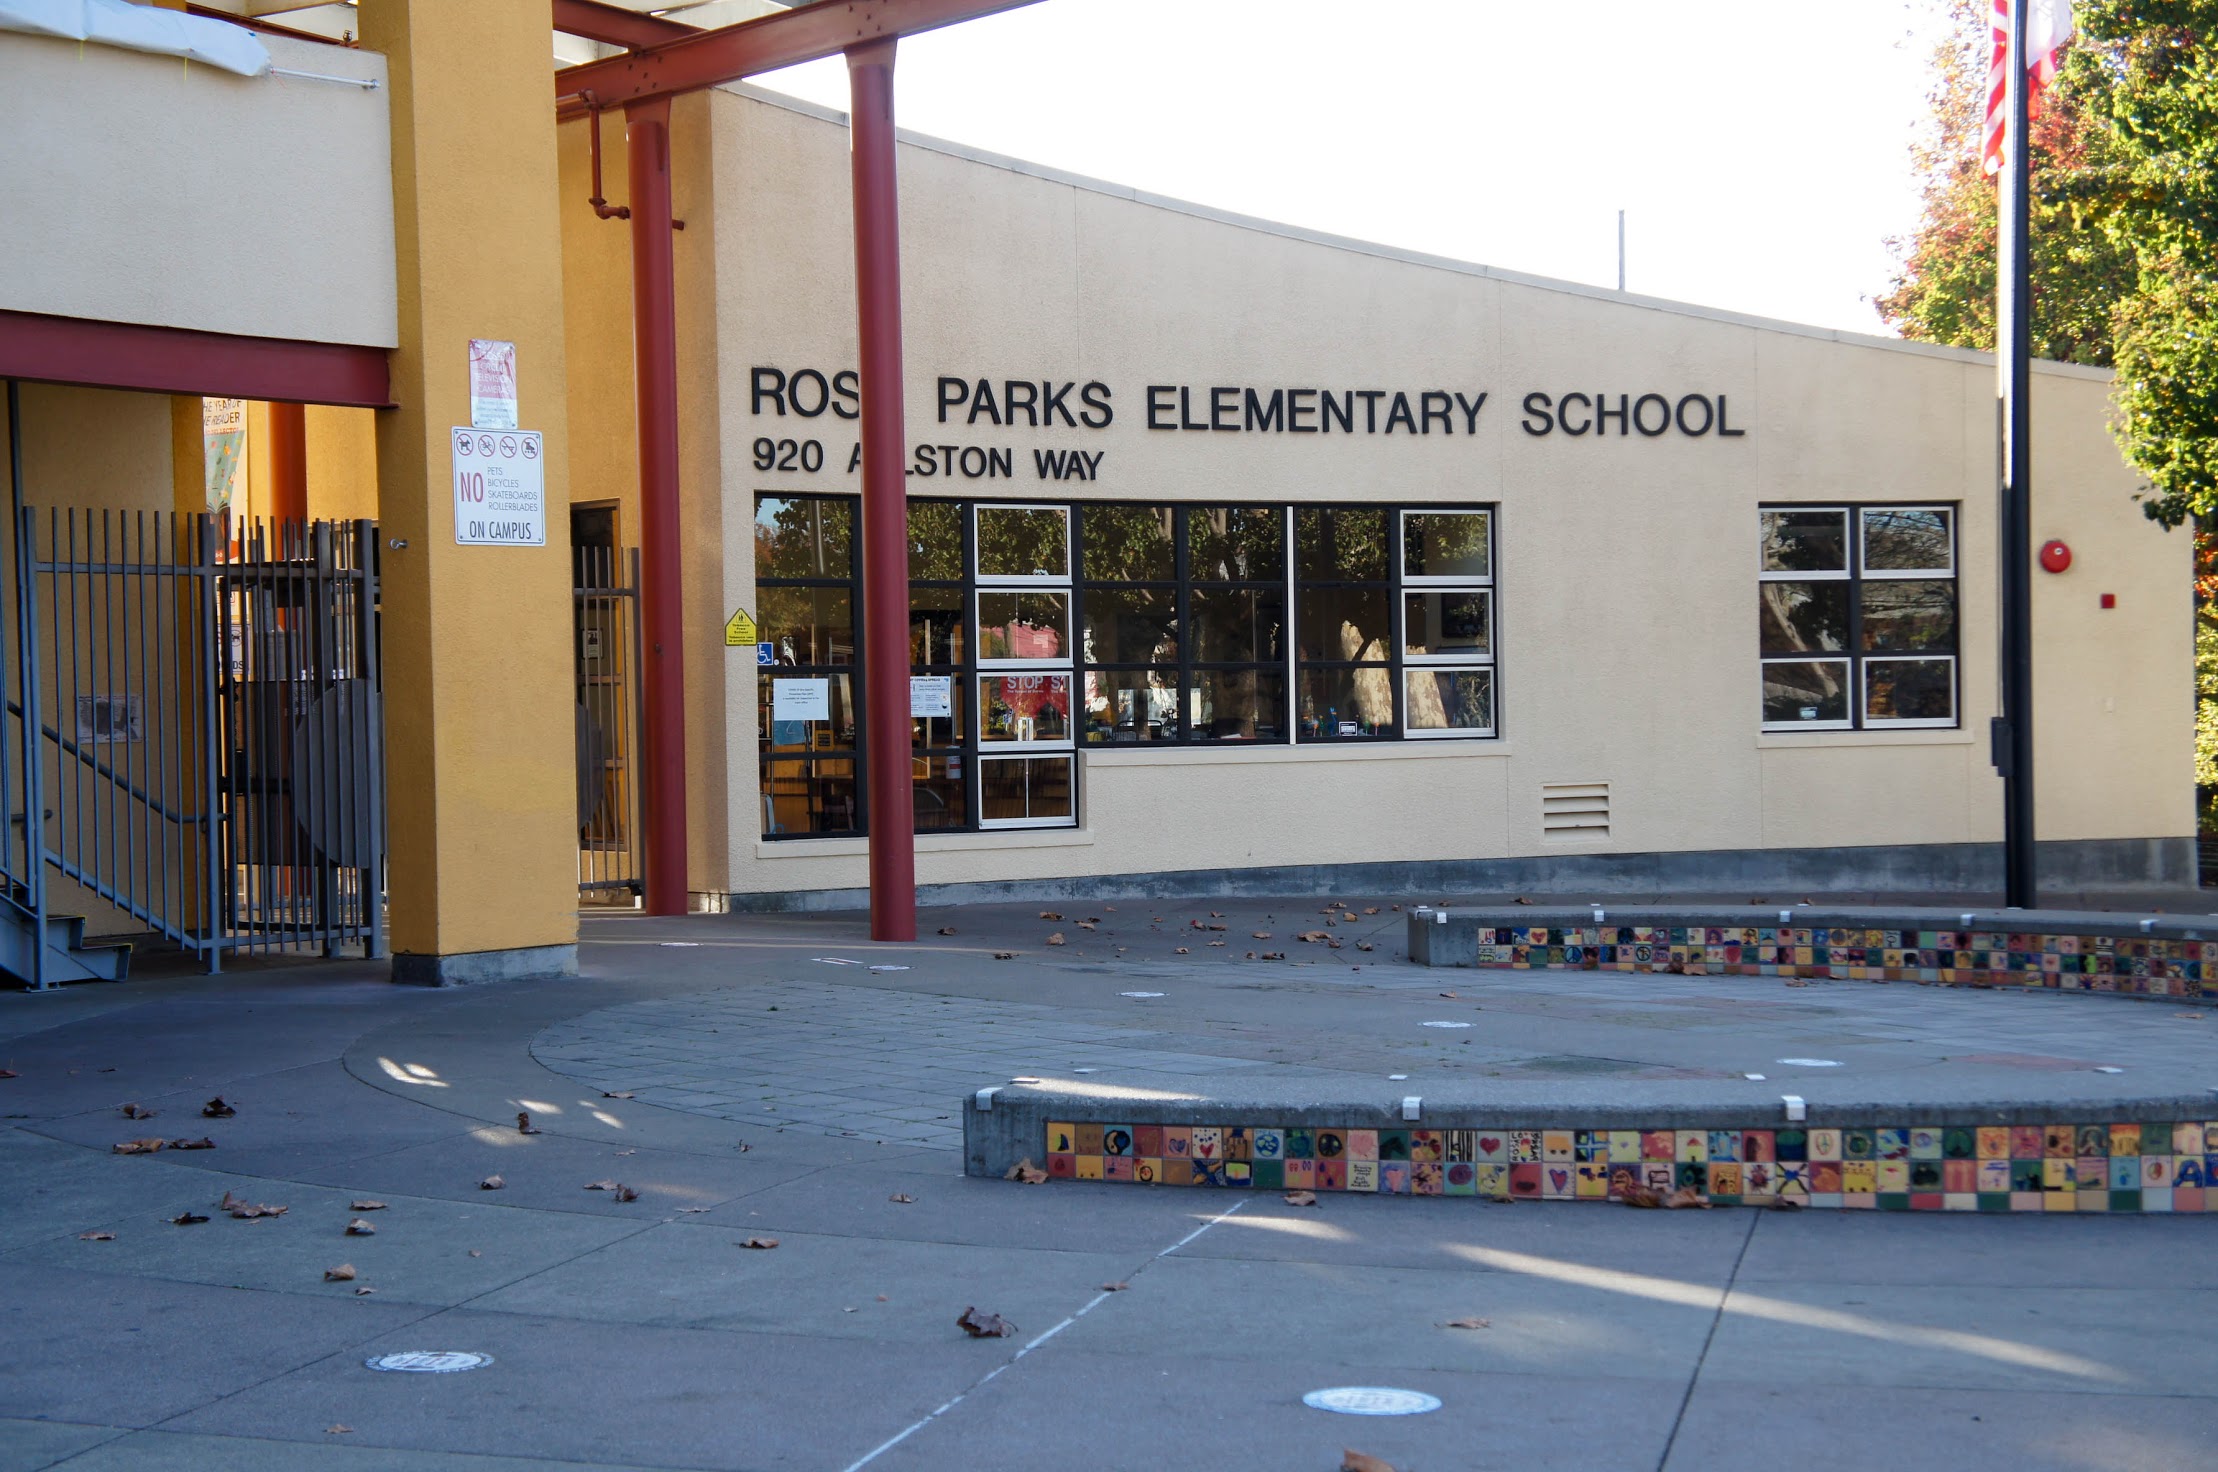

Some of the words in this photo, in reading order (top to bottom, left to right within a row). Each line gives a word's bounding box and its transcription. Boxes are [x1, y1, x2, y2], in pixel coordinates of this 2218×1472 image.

[751, 367, 859, 419] ROS
[937, 376, 1113, 429] PARKS
[1146, 384, 1489, 434] ELEMENTARY
[1521, 391, 1746, 437] SCHOOL
[753, 437, 824, 473] 920
[847, 441, 1012, 478] ASTON
[1034, 449, 1104, 480] WAY
[487, 466, 502, 476] PETS
[460, 471, 484, 503] NO
[487, 478, 519, 488] BICYCLES
[487, 489, 538, 500] SKATEBOARDS
[488, 501, 538, 512] ROLLERBLADES
[469, 520, 485, 539] ON
[489, 521, 532, 540] CAMPUS
[1007, 676, 1044, 689] STOP
